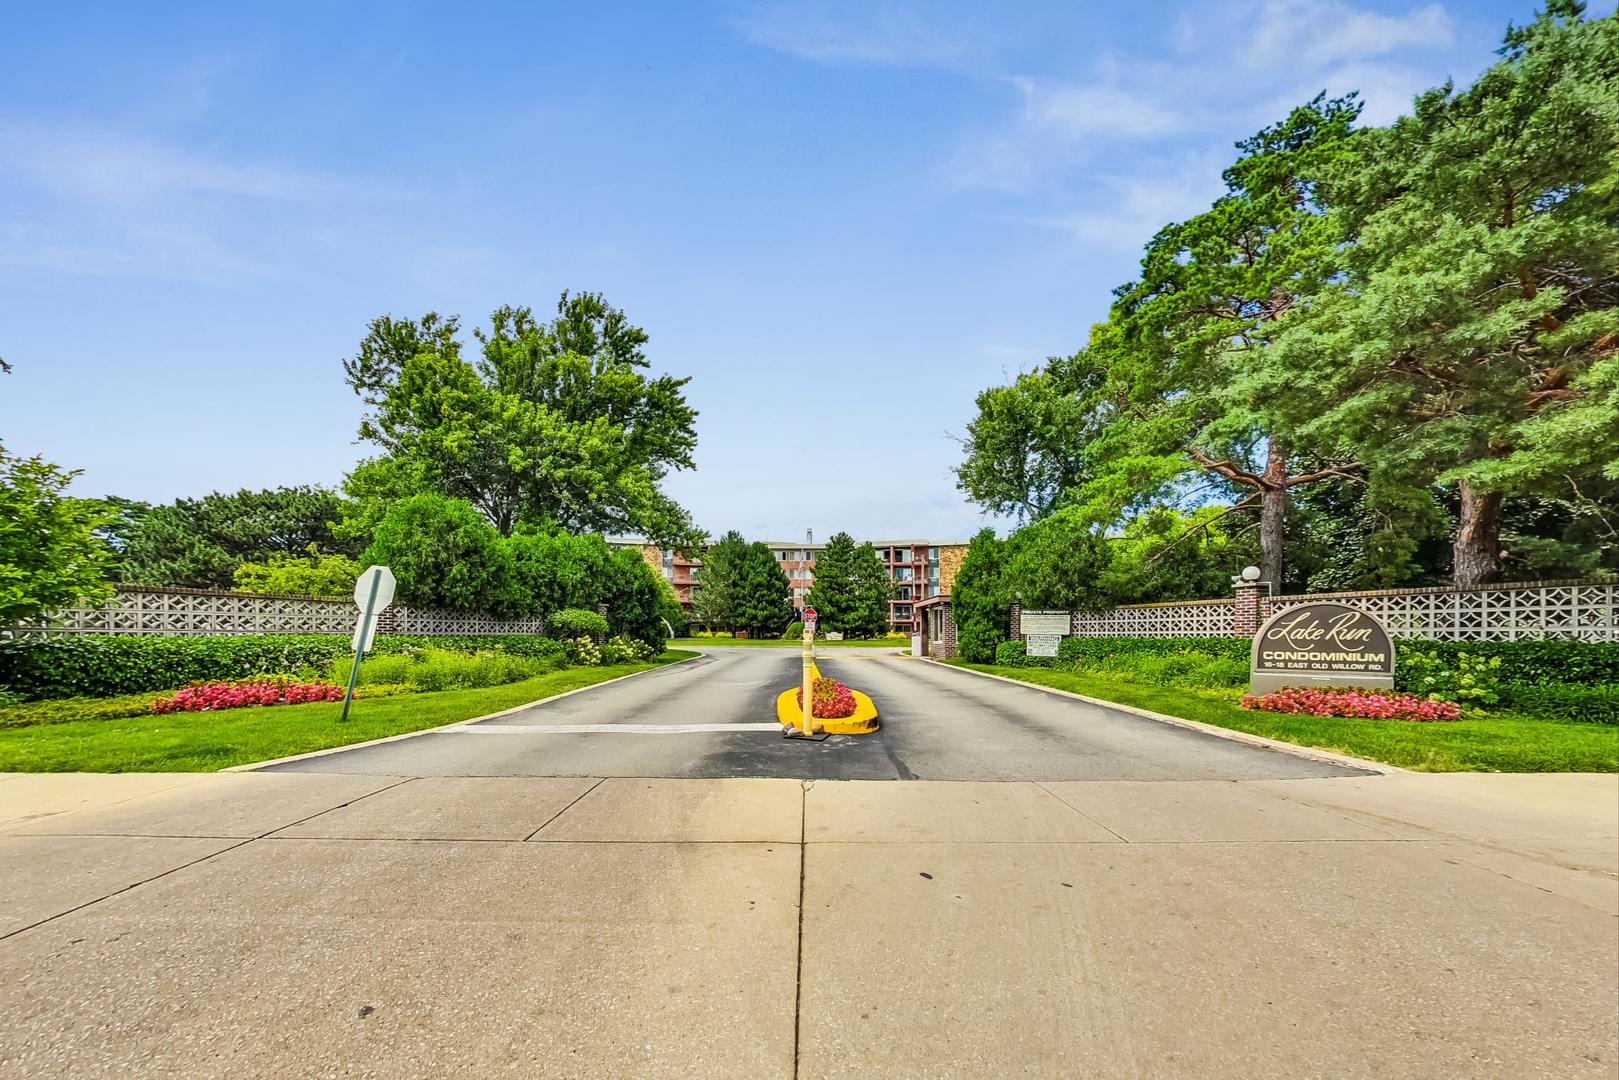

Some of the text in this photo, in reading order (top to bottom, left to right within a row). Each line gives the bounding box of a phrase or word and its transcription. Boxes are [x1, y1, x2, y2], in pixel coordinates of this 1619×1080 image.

[1267, 611, 1372, 651] Lake Run
[1263, 651, 1385, 662] CONDOMINIUM
[1368, 663, 1384, 671] RD.
